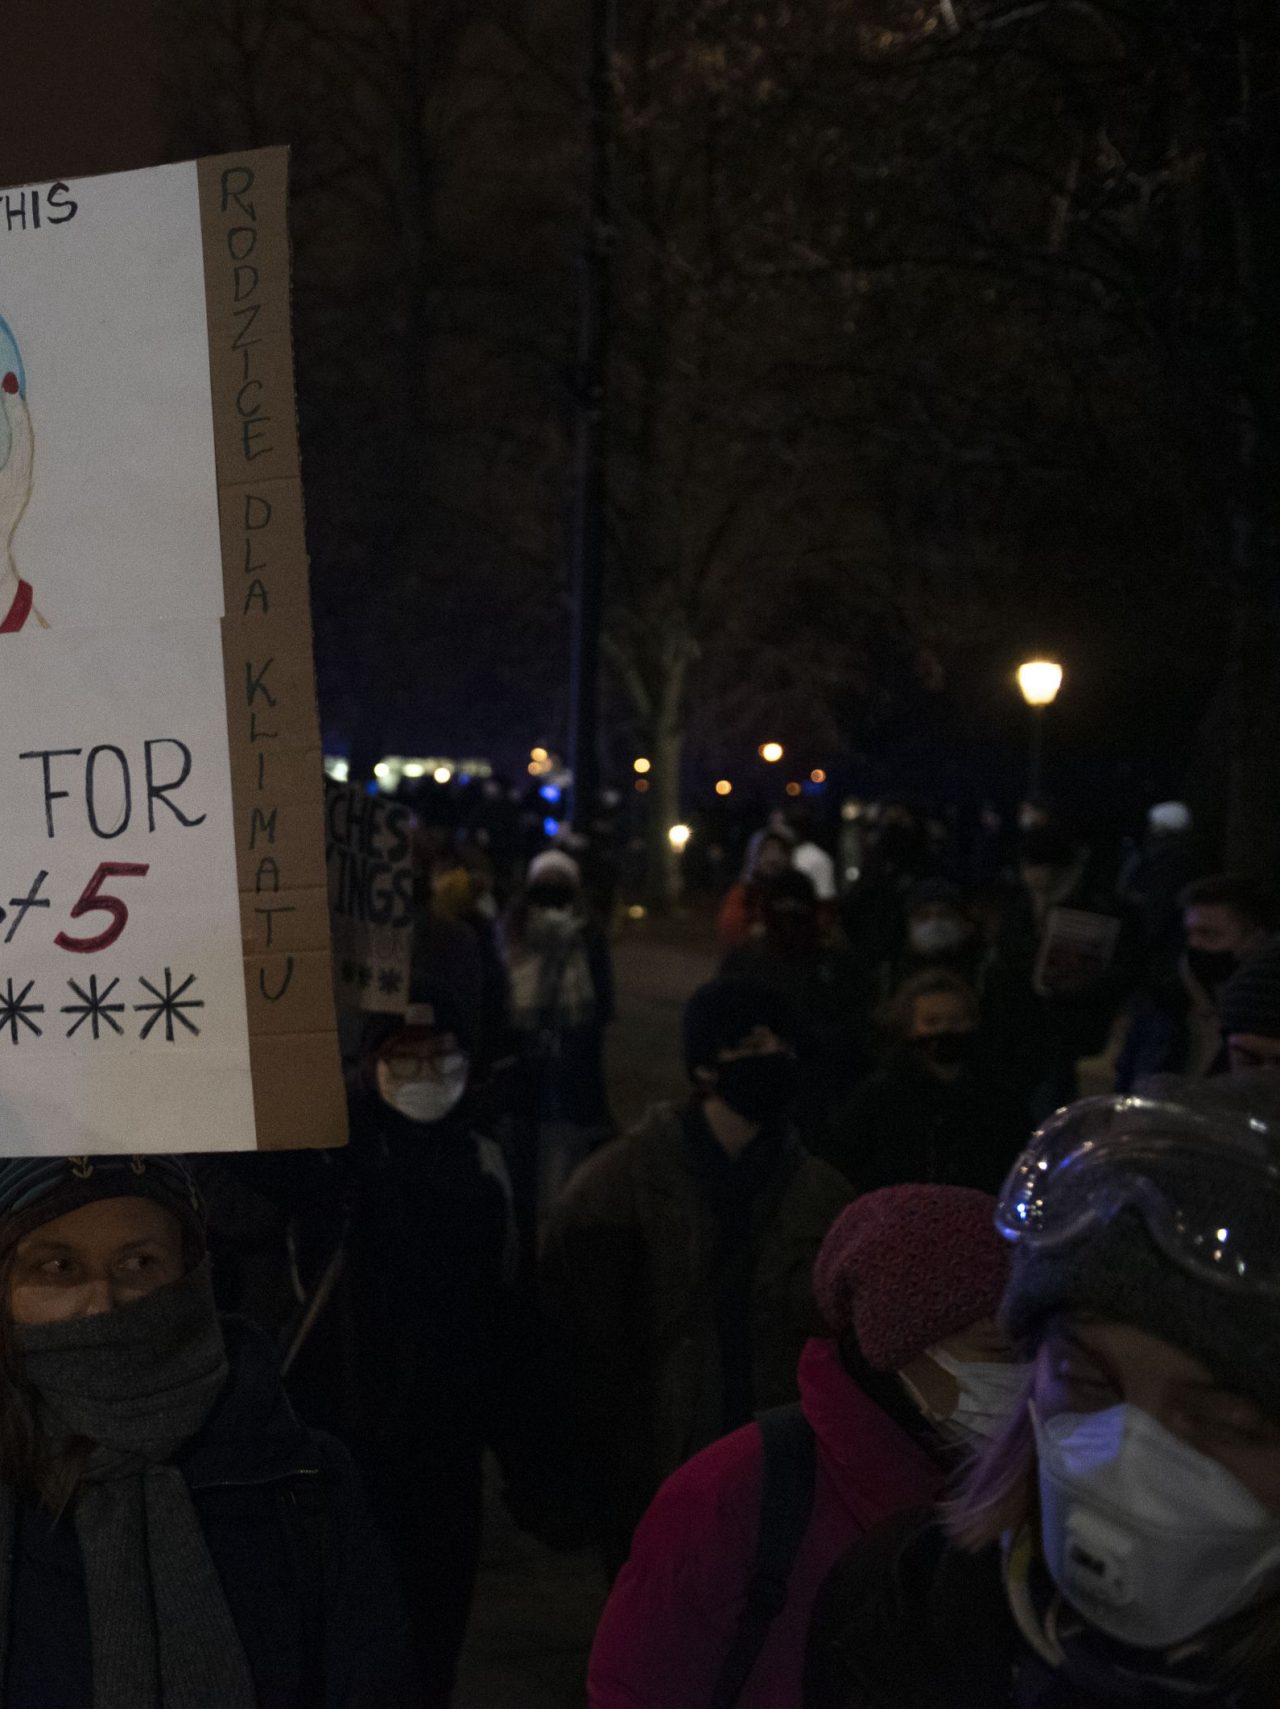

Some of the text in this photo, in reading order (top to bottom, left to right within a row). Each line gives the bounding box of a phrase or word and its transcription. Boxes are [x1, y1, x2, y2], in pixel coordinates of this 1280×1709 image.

[18, 738, 207, 840] FOR
[221, 165, 297, 1003] RODZICE DLA KLIMATU
